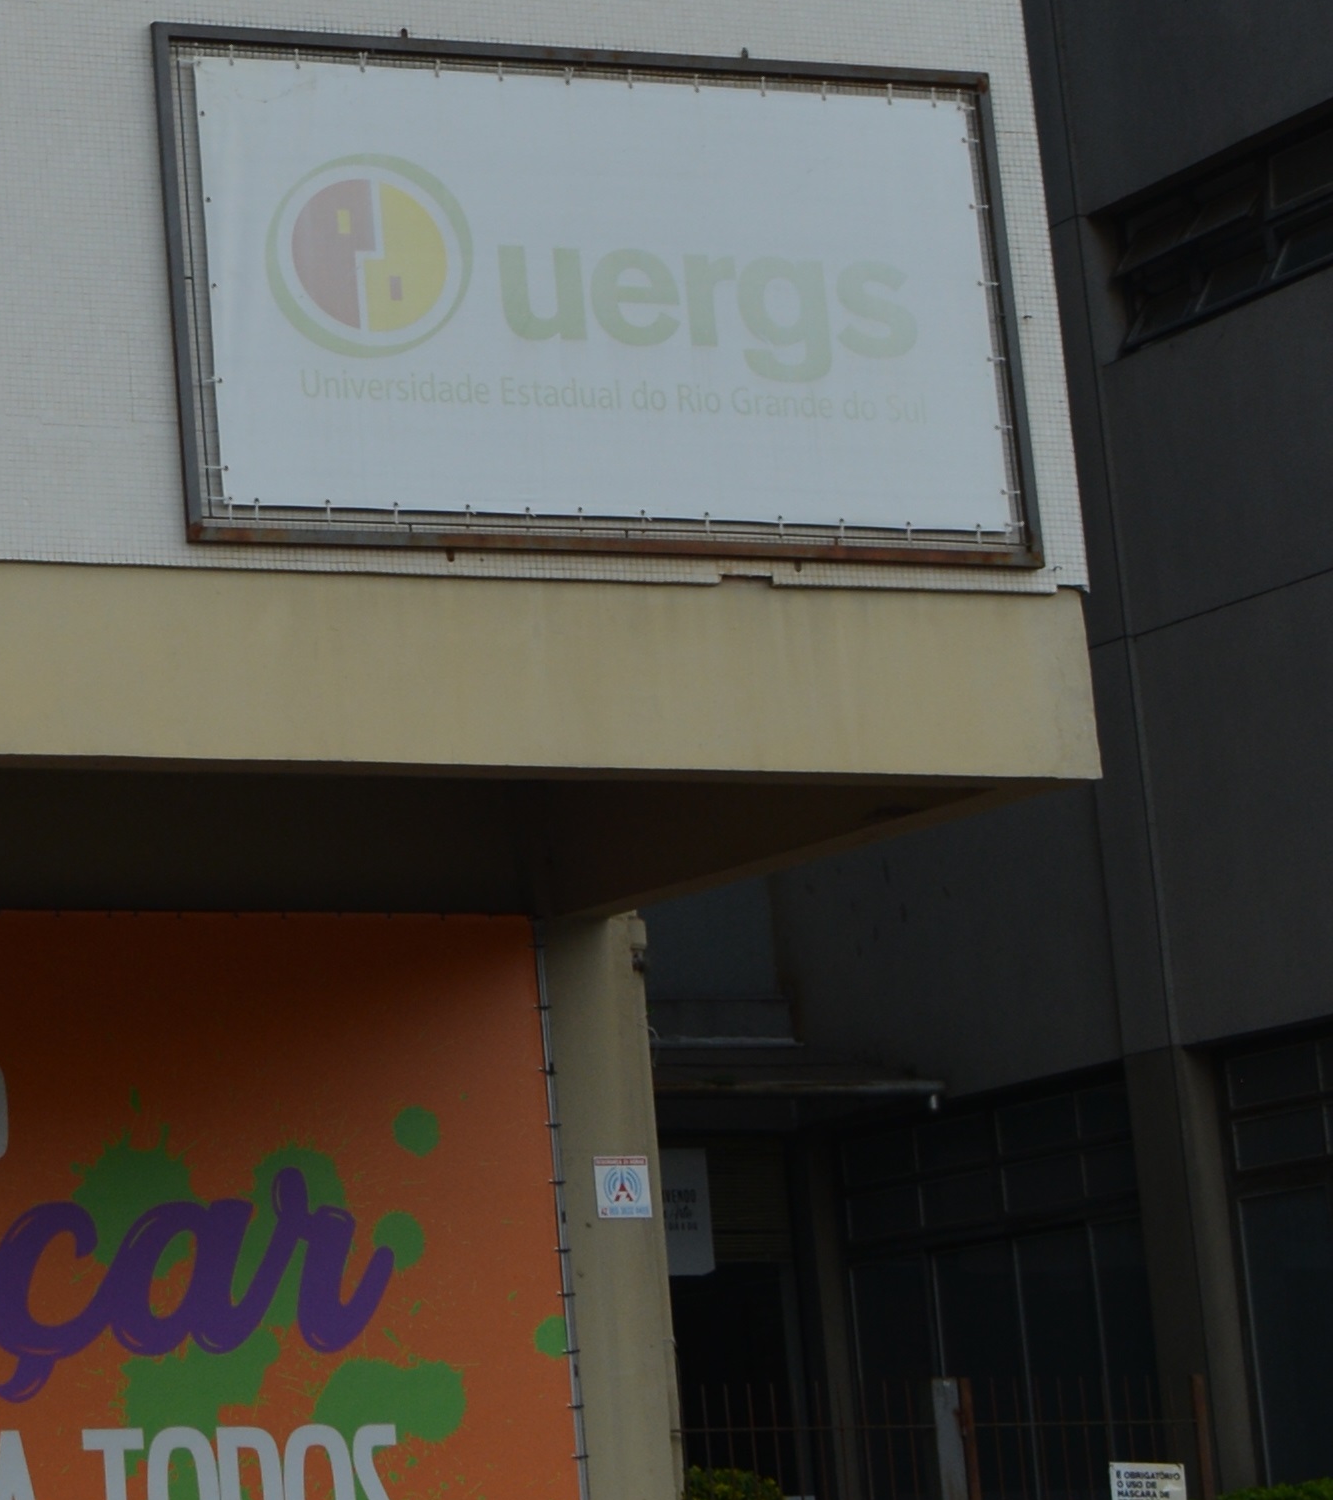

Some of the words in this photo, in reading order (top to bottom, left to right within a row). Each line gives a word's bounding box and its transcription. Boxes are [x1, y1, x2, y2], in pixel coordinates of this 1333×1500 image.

[496, 242, 920, 384] uergs
[300, 368, 491, 406] Universidade
[500, 376, 622, 410] Estadual
[631, 380, 668, 413] do
[676, 383, 721, 415] Rio
[731, 386, 834, 420] Grande
[842, 390, 877, 423] do
[886, 392, 928, 426] Sul
[1124, 1470, 1181, 1481] OBRIGATÓRIO
[1117, 1480, 1124, 1489] O
[1126, 1481, 1143, 1489] USO
[1145, 1481, 1157, 1489] DE
[1159, 1491, 1170, 1499] DE
